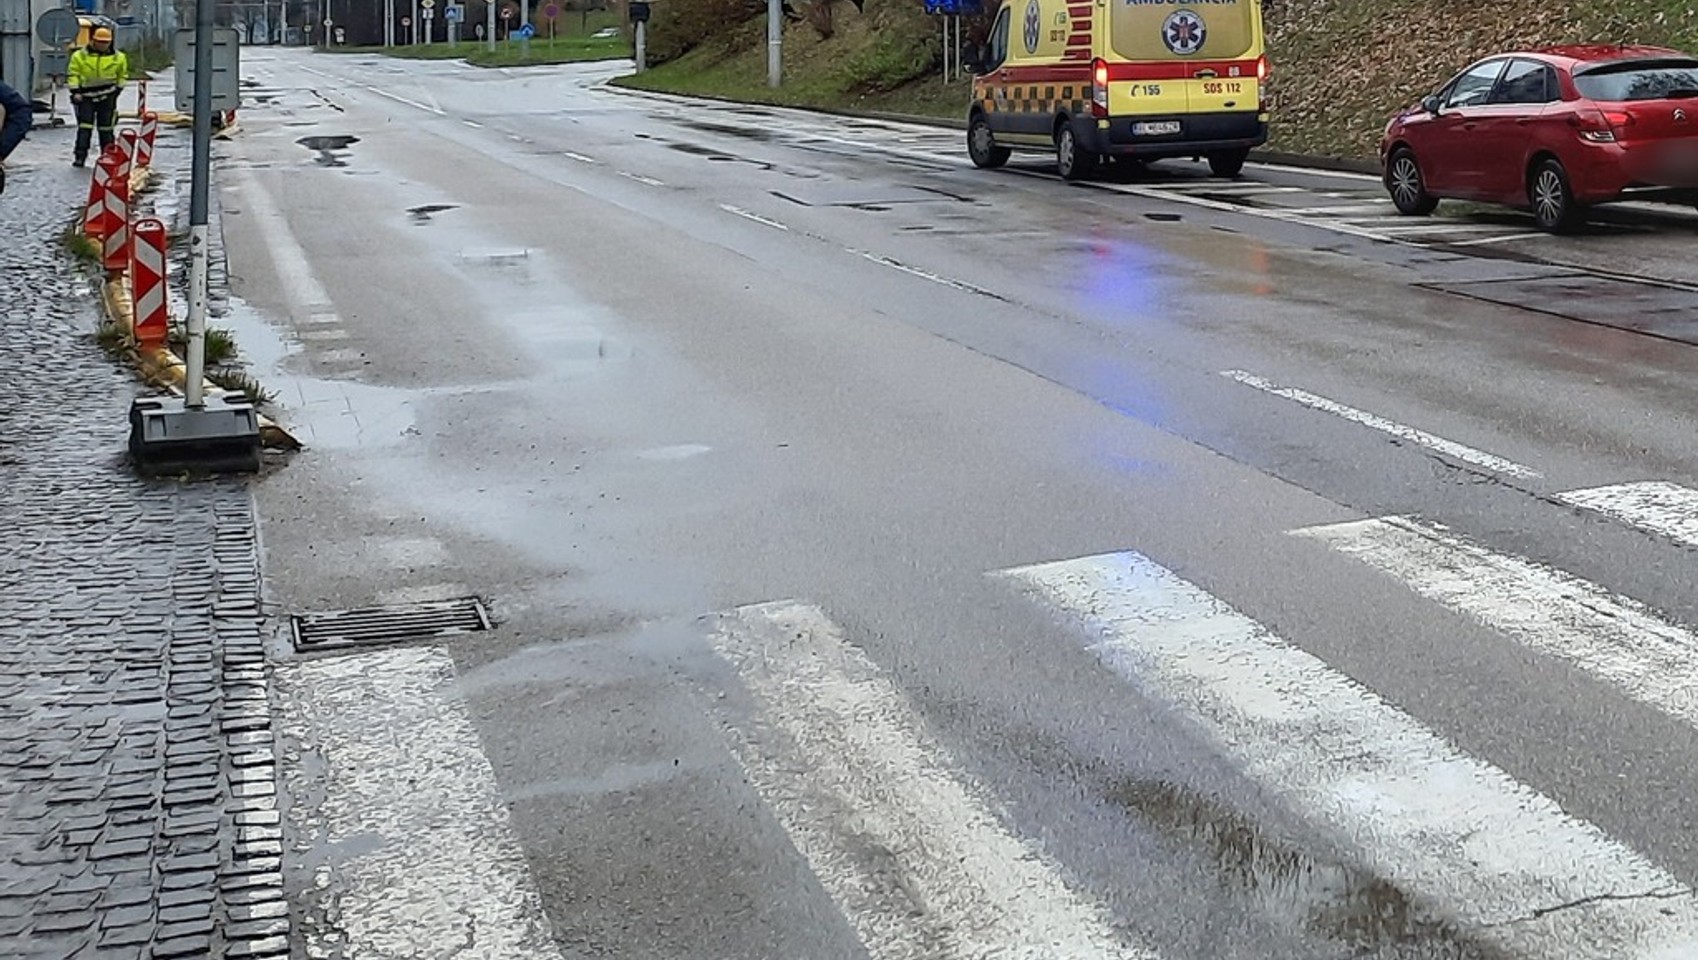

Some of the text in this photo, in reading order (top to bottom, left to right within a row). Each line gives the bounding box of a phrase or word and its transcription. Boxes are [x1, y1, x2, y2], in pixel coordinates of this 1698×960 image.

[1143, 84, 1161, 96] 155
[1203, 82, 1241, 94] SOS 112
